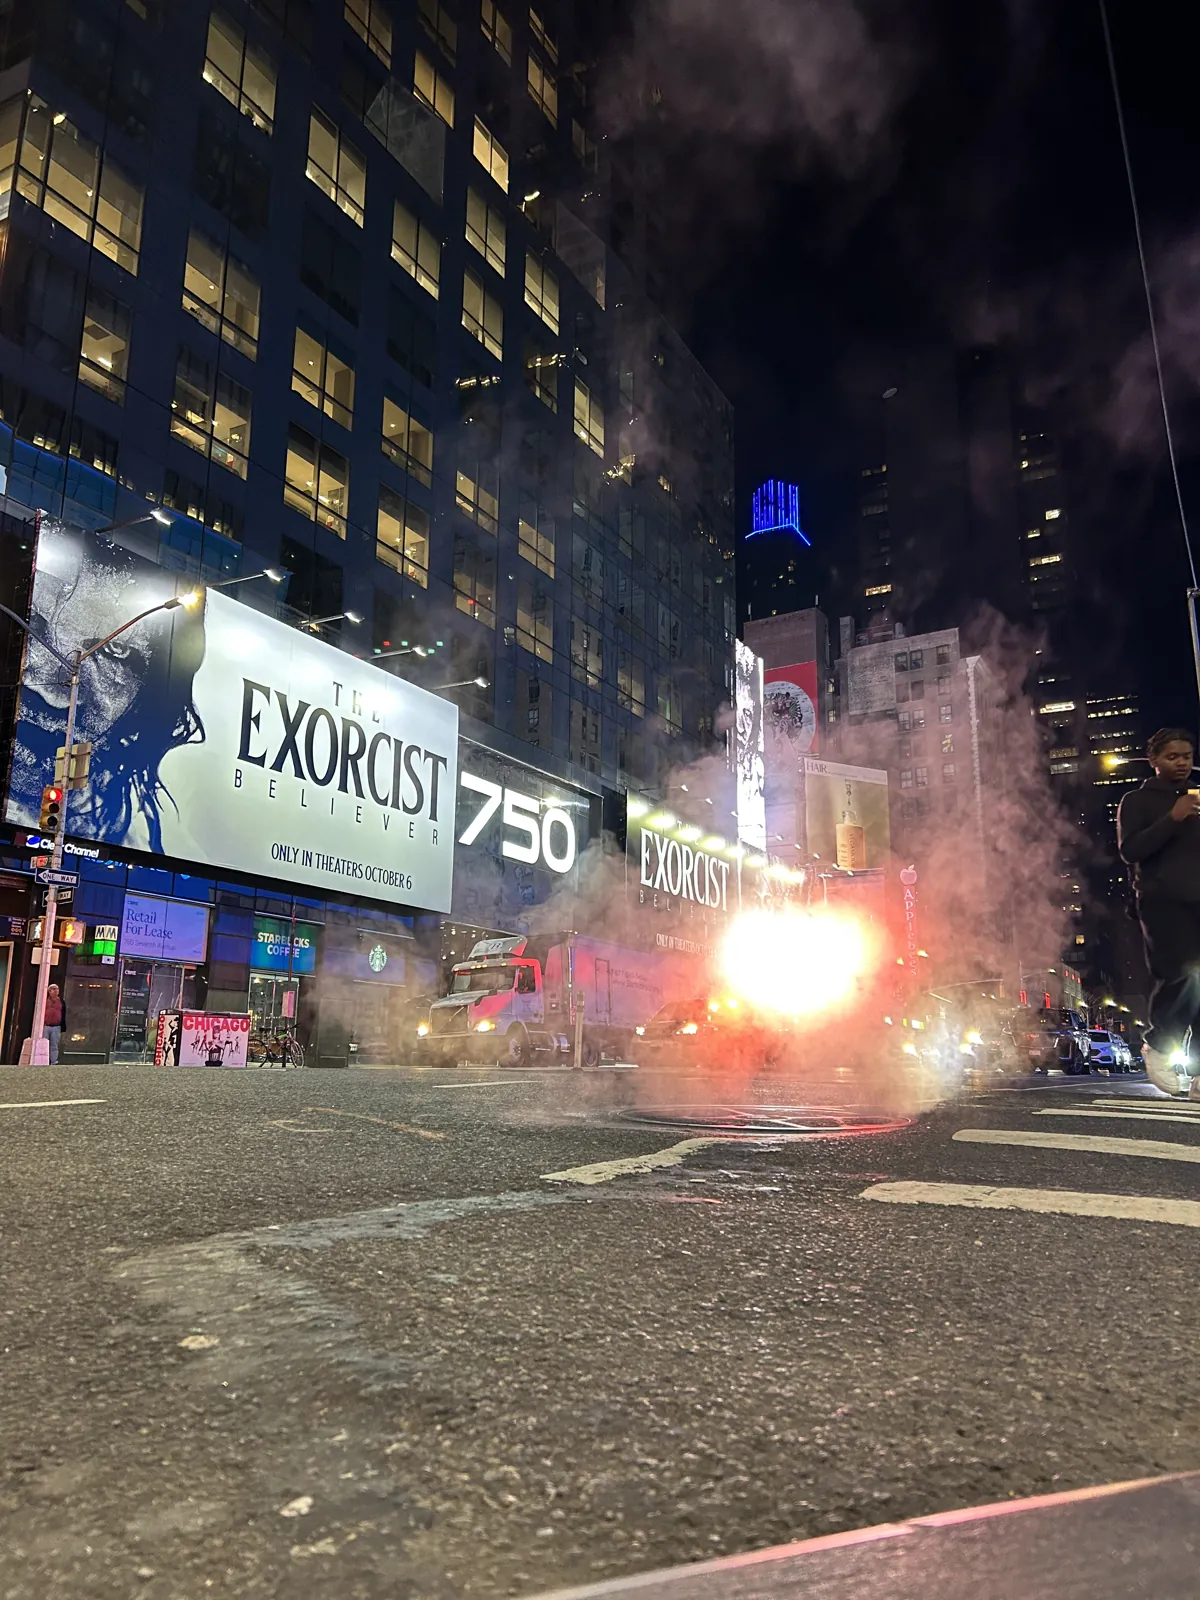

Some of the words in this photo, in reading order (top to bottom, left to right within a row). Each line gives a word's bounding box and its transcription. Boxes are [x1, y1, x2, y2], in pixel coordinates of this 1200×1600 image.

[237, 677, 448, 823] EXORCIST
[234, 768, 438, 846] BELIEVER
[458, 771, 576, 874] 750
[40, 838, 64, 850] Cle
[64, 843, 100, 858] Channel
[42, 872, 56, 880] ONE
[60, 875, 75, 883] WAY
[271, 842, 299, 864] ONLY
[301, 849, 313, 868] IN
[315, 852, 363, 880] THEATERS
[364, 865, 405, 889] OCTOBER
[405, 875, 412, 890] 6
[640, 827, 730, 912] EXORCIST
[125, 921, 143, 936] For
[144, 924, 173, 940] Lease
[126, 908, 157, 924] Retail
[656, 932, 669, 947] ONLY
[182, 1014, 250, 1032] CHICAGO
[154, 1015, 166, 1066] CHICAGO
